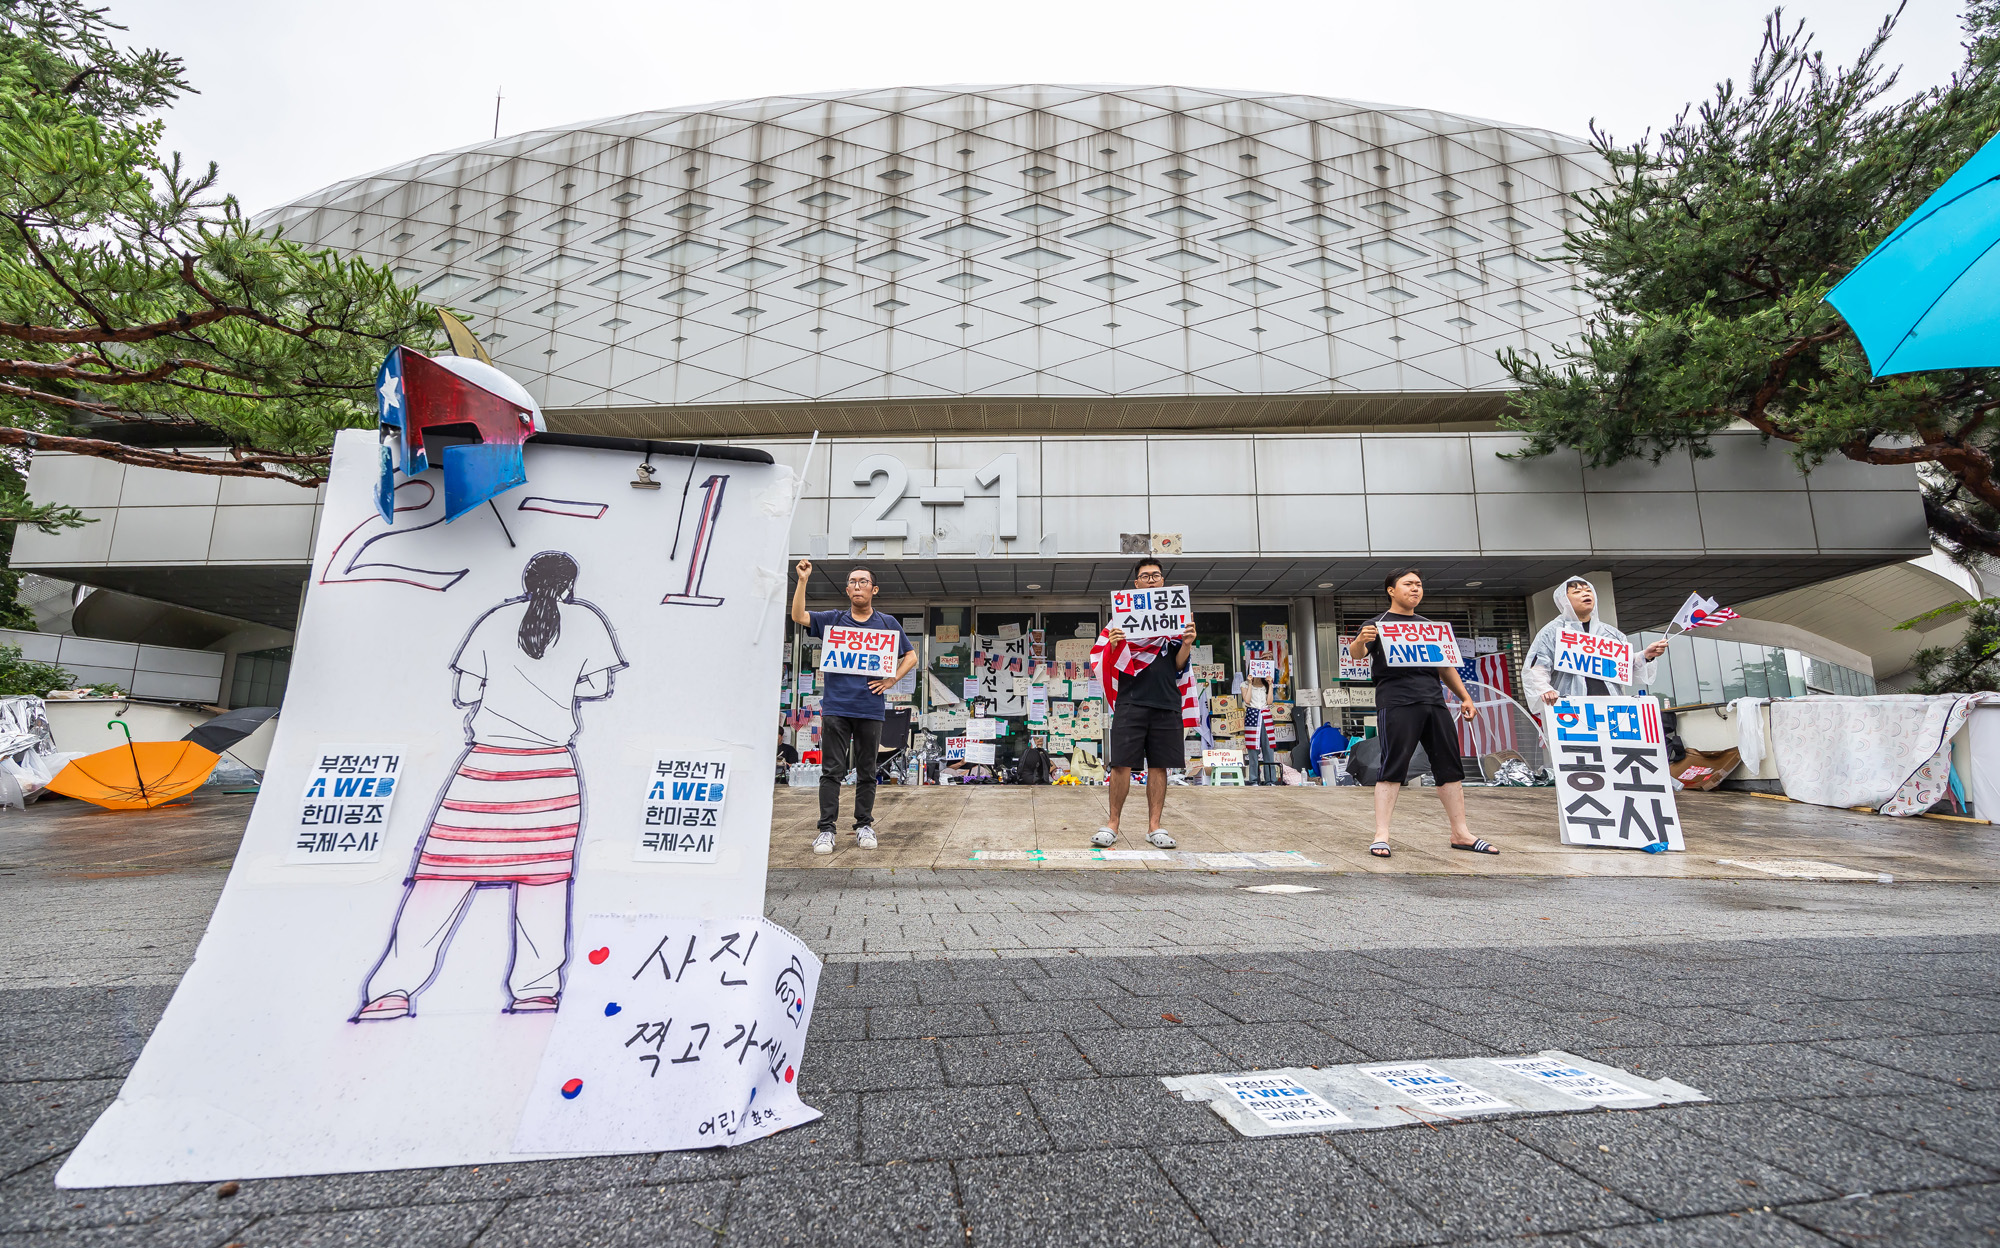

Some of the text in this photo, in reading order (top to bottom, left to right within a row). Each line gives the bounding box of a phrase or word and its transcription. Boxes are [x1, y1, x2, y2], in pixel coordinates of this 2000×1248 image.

[851, 453, 1018, 540] 2-1
[1114, 589, 1187, 613] 한미공조
[1122, 613, 1186, 633] 수사해!
[1382, 623, 1453, 642] 부정선거
[828, 629, 896, 652] 부정선거
[1560, 631, 1629, 661] 부정선거
[823, 650, 880, 671] AWEB
[1389, 644, 1444, 664] AWEB
[1558, 650, 1617, 678] AWEB
[1553, 701, 1660, 744] 한미
[947, 749, 966, 758] AWE
[319, 756, 399, 773] 부정선거
[656, 760, 725, 779] 부정선거
[1559, 745, 1666, 793] 공조
[301, 805, 384, 825] 한미공조
[645, 806, 717, 826] 한미공조
[1565, 793, 1675, 843] 수사
[297, 832, 379, 853] 국제수사
[643, 833, 714, 852] 국제수사
[632, 931, 759, 986] 사진
[1226, 1079, 1294, 1089] 부정선거
